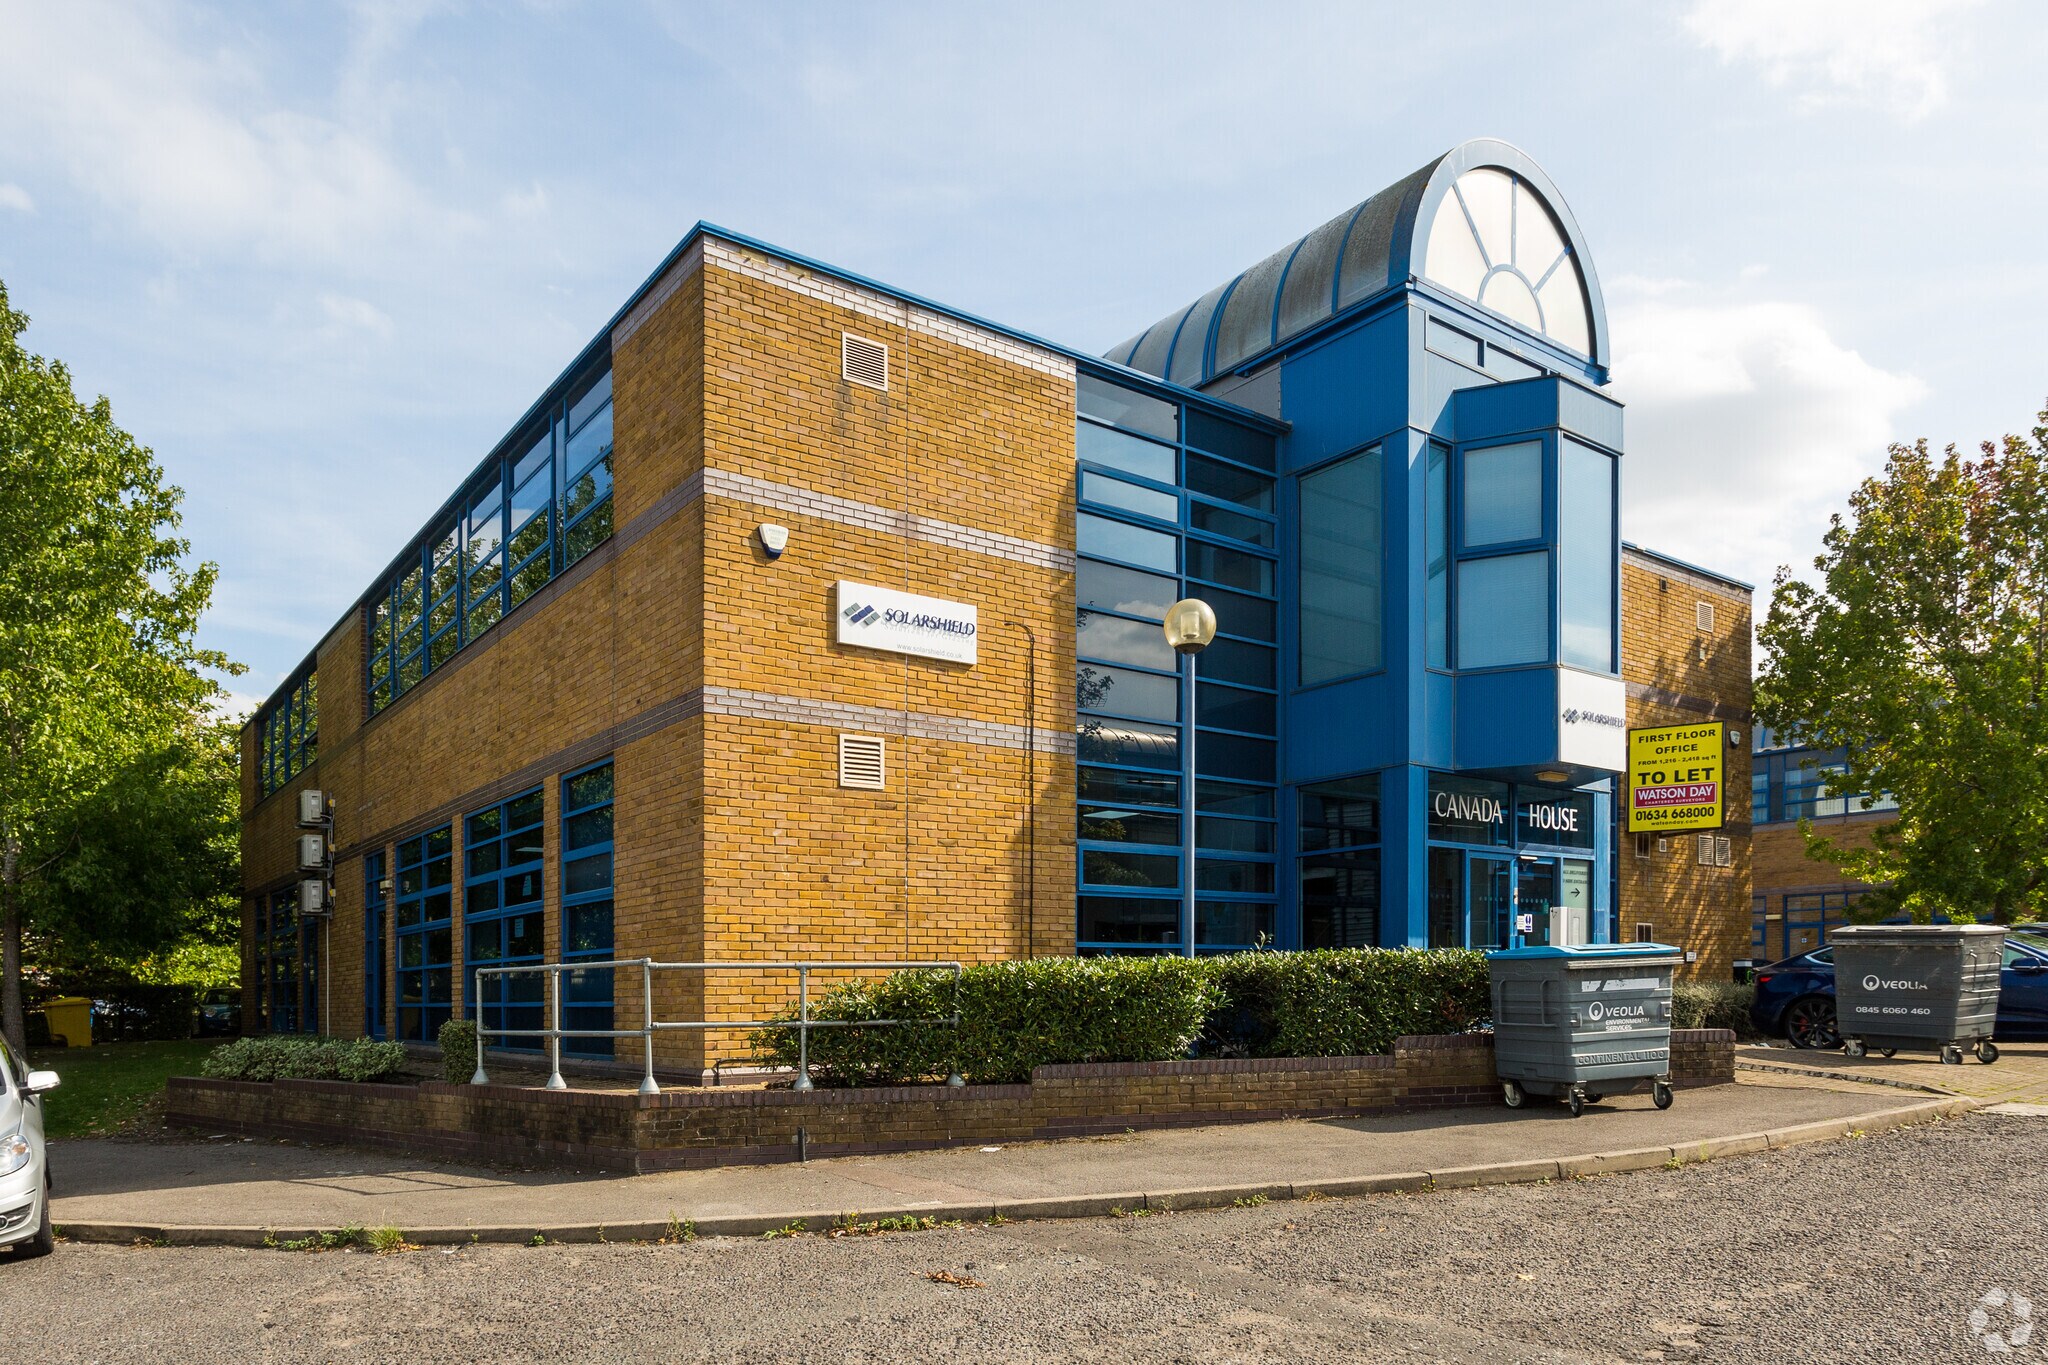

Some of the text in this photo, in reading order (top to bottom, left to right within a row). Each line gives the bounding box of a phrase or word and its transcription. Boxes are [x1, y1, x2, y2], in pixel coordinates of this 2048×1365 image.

[885, 608, 975, 635] SOLARSHIELD
[1638, 729, 1716, 743] FIRST FLOOR
[1655, 744, 1698, 754] OFFICE
[1638, 767, 1715, 785] TO LET
[1638, 785, 1713, 800] WATSON DAY
[1435, 792, 1578, 832] CANADA HOUSE
[1635, 806, 1715, 821] 01634 668000
[1605, 1005, 1644, 1017] VEOLIA
[1855, 1006, 1931, 1015] 0845 6060 460
[1605, 1024, 1632, 1032] SERVICES
[1578, 1050, 1665, 1065] CONTINENTAL 1100
